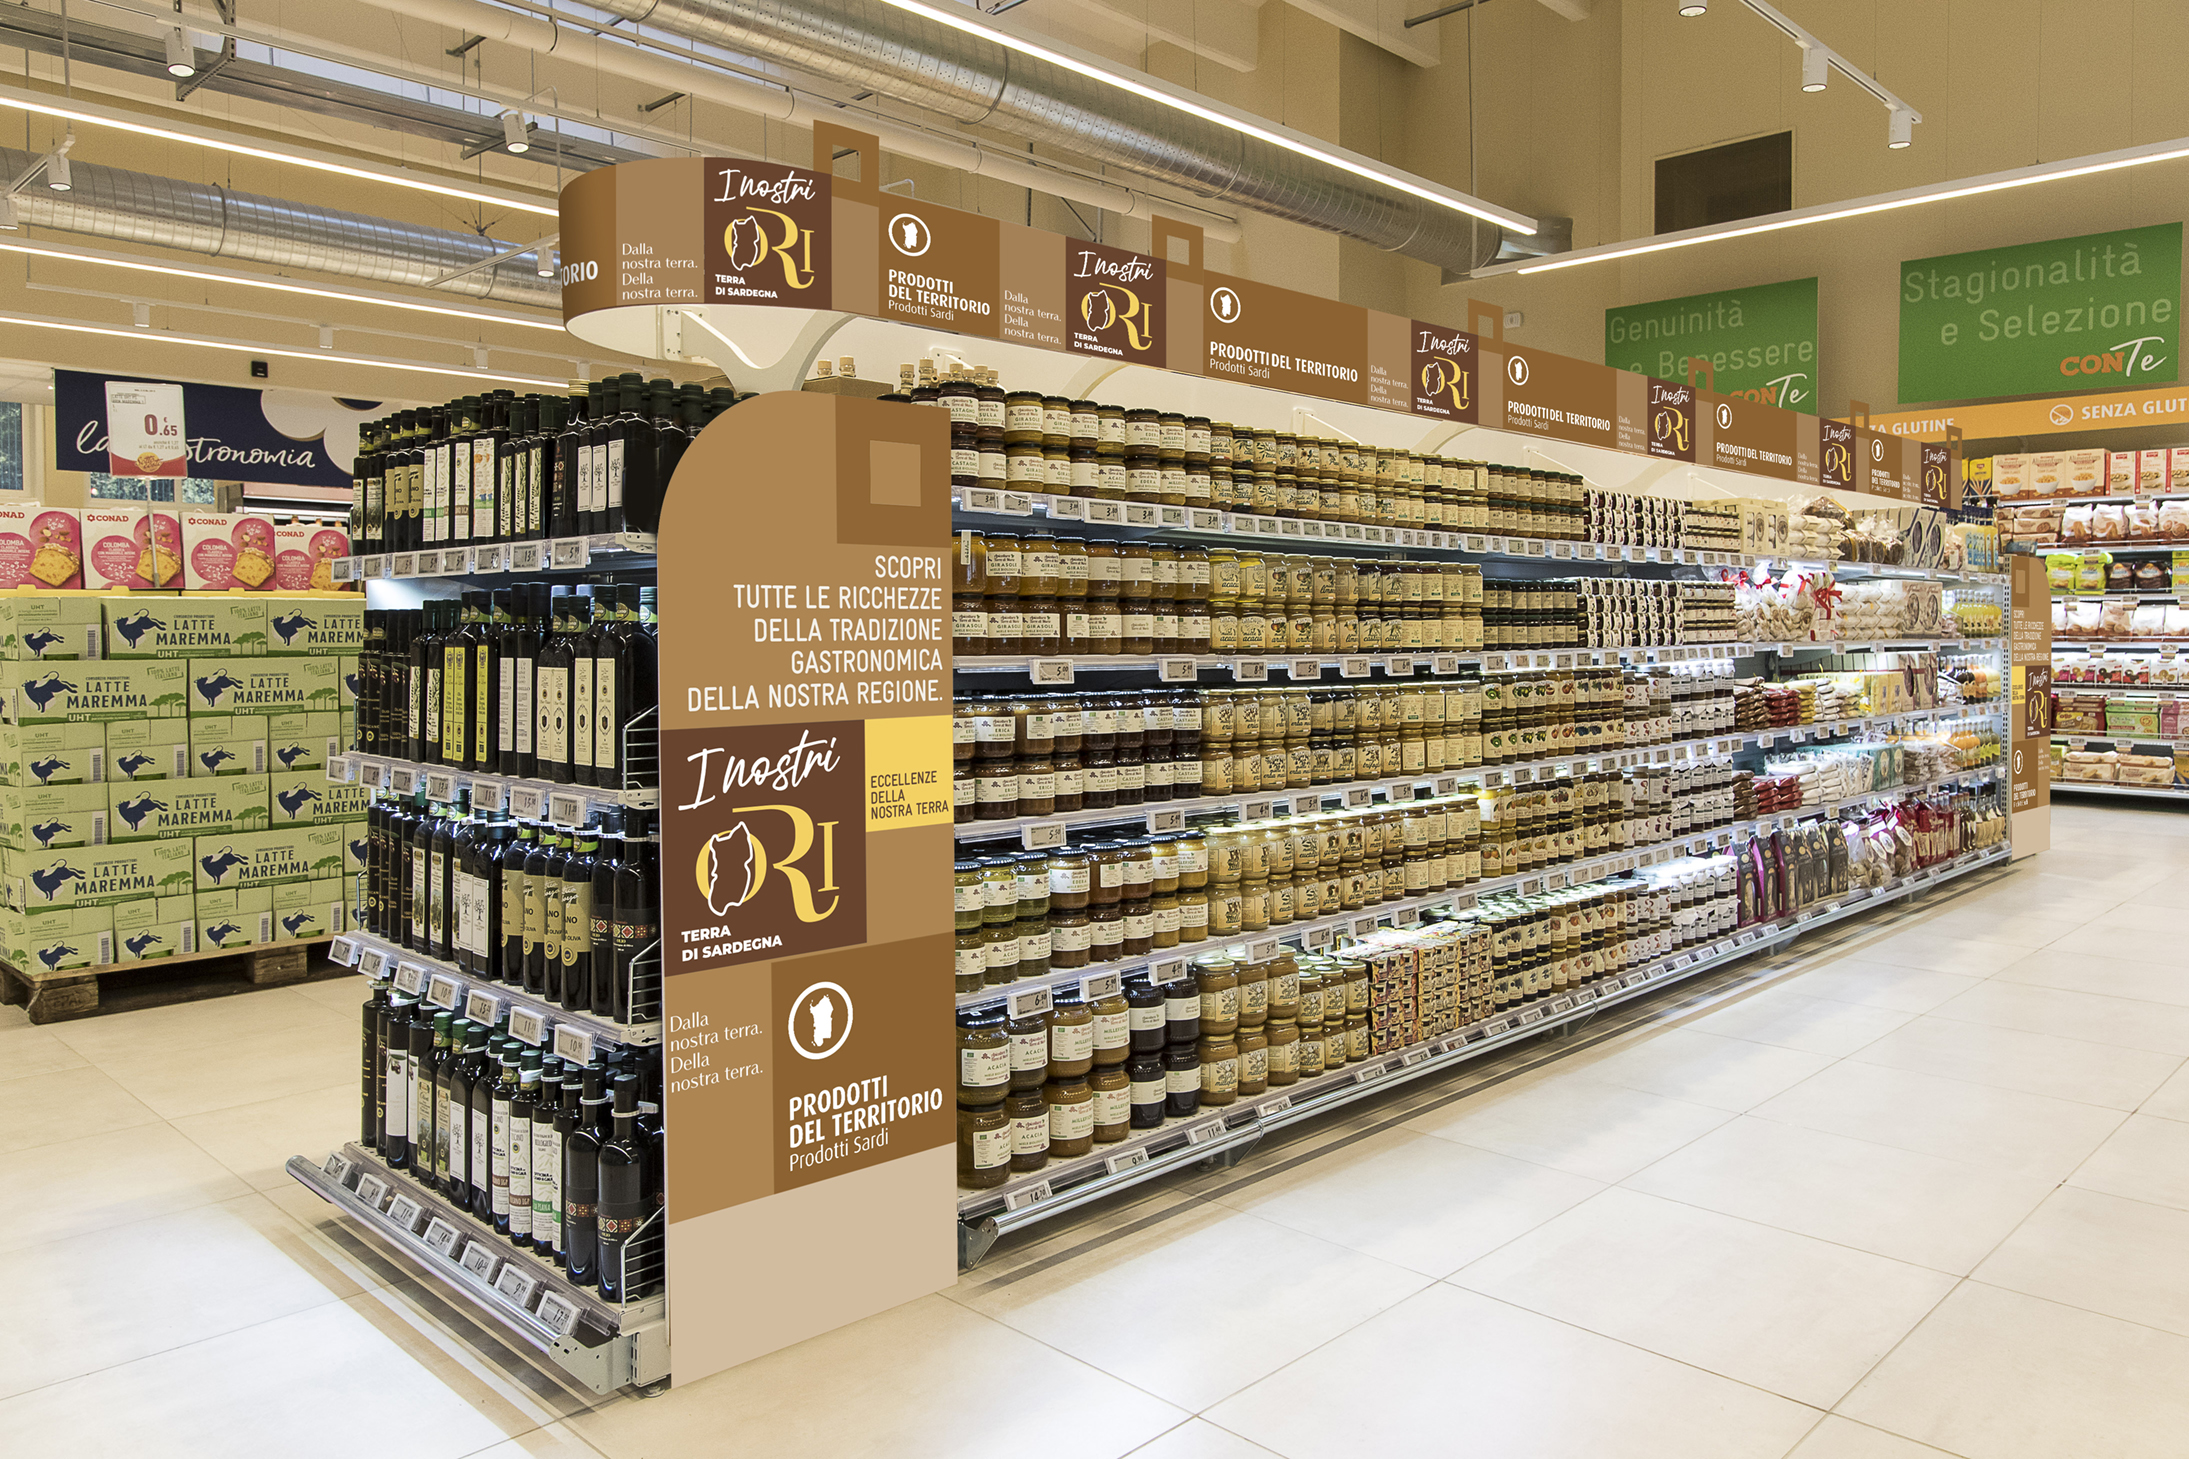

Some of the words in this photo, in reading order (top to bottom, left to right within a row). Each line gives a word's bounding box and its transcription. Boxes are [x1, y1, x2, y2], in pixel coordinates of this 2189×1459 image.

[740, 170, 816, 204] nostri
[622, 242, 654, 255] Dalla
[724, 205, 815, 289] ORI
[622, 257, 661, 270] nostra
[665, 256, 698, 269] terra.
[1094, 255, 1153, 283] nostri
[1904, 242, 2143, 303] Stagionalità
[561, 260, 598, 289] ORIO
[622, 272, 654, 285] Della
[715, 273, 746, 285] TERRA
[888, 268, 954, 294] PRODOTTI
[622, 286, 661, 300] nostra
[665, 286, 698, 298] terra.
[715, 286, 726, 296] DI
[727, 287, 778, 299] SARDEGNA
[888, 284, 912, 301] DEL
[916, 289, 990, 316] TERRITORIO
[1004, 290, 1029, 304] Dalla
[888, 300, 928, 317] Prodotti
[930, 306, 954, 321] Sardi
[1004, 304, 1034, 318] nostra
[1037, 310, 1062, 322] terra.
[1004, 313, 1029, 327] Della
[1081, 282, 1153, 351] ORI
[1610, 299, 1744, 344] Genuinità
[1941, 320, 1959, 346] e
[1978, 297, 2172, 342] Selezione
[1004, 327, 1034, 340] nostra
[1037, 333, 1062, 345] terra.
[1074, 332, 1098, 343] TERRA
[1430, 334, 1470, 355] nostri
[1074, 341, 1083, 349] DI
[1084, 342, 1123, 356] SARDEGNA
[1210, 341, 1269, 366] PRODOTTI
[1272, 354, 1291, 370] DEL
[1295, 358, 1358, 382] TERRITORIO
[1210, 358, 1246, 375] Prodotti
[1248, 365, 1270, 379] Sardi
[1630, 361, 1643, 374] e
[1658, 341, 1814, 378] Beessere
[1370, 365, 1387, 376] Dalla
[1370, 376, 1391, 386] nostra
[1392, 379, 1409, 389] terra.
[1370, 384, 1387, 395] Della
[1422, 356, 1469, 410] ORI
[1370, 395, 1391, 405] nostra
[1392, 398, 1409, 408] terra.
[1417, 397, 1434, 406] TERRA
[1423, 406, 1450, 415] SARDEGNA
[2081, 402, 2137, 420] SENZA
[2142, 398, 2188, 415] GLUT
[1508, 400, 1549, 420] PRODOTTI
[1550, 409, 1564, 423] DEL
[1566, 411, 1611, 431] TERRITORIO
[1508, 415, 1533, 428] Prodotti
[1534, 419, 1549, 431] Sardi
[1654, 406, 1690, 452] ORI
[186, 436, 316, 468] stronomia
[1716, 442, 1747, 458] PRODOTTI
[1747, 450, 1758, 460] DEL
[1759, 451, 1792, 466] TERRITORIO
[197, 518, 227, 526] CONAD
[875, 555, 942, 579] SCOPRI
[733, 584, 797, 609] TUTTE
[806, 585, 830, 609] LE
[839, 586, 942, 610] RICCHEZZE
[174, 619, 215, 630] LATTE
[323, 619, 361, 629] LATTE
[754, 618, 822, 642] DELLA
[830, 618, 942, 641] TRADIZIONE
[156, 632, 231, 645] MAREMMA
[308, 631, 365, 643] MAREMM
[157, 650, 179, 658] UHT
[791, 648, 943, 674] GASTRONOMICA
[86, 681, 130, 693] LATTE
[250, 677, 289, 688] LATTE
[67, 694, 147, 709] MAREMMA
[234, 690, 304, 704] MAREMMA
[688, 685, 760, 712] DELLA
[768, 682, 849, 709] NOSTRA
[857, 679, 943, 704] REGIONE.
[722, 729, 840, 793] nostri
[870, 770, 937, 789] ECCELLENZE
[328, 787, 365, 799] LATTE
[870, 789, 905, 804] DELLA
[175, 797, 217, 810] LATTE
[313, 799, 370, 815] MAREMM
[871, 803, 913, 820] NOSTRA
[916, 800, 949, 815] TERRA
[158, 809, 233, 827] MAREMMA
[256, 850, 294, 863] LATTE
[695, 804, 840, 923] ORI
[94, 863, 138, 878] LATTE
[239, 861, 309, 880] MAREMMA
[74, 875, 155, 895] MAREMMA
[681, 925, 731, 943] TERRA
[681, 947, 699, 962] DI
[702, 935, 782, 959] SARDEGNA
[670, 1011, 709, 1033] Dalla
[670, 1032, 719, 1052] nostra
[724, 1022, 763, 1042] terra.
[671, 1052, 710, 1074] Della
[987, 1062, 1007, 1071] ACACIA
[671, 1073, 720, 1093] nostra
[725, 1063, 763, 1082] terra.
[789, 1075, 888, 1121] PRODOTTI
[789, 1118, 825, 1148] DEL
[832, 1087, 943, 1137] TERRITORIO
[1021, 1132, 1043, 1140] ACACIA
[789, 1138, 849, 1172] Prodotti
[853, 1128, 889, 1153] Sardi
